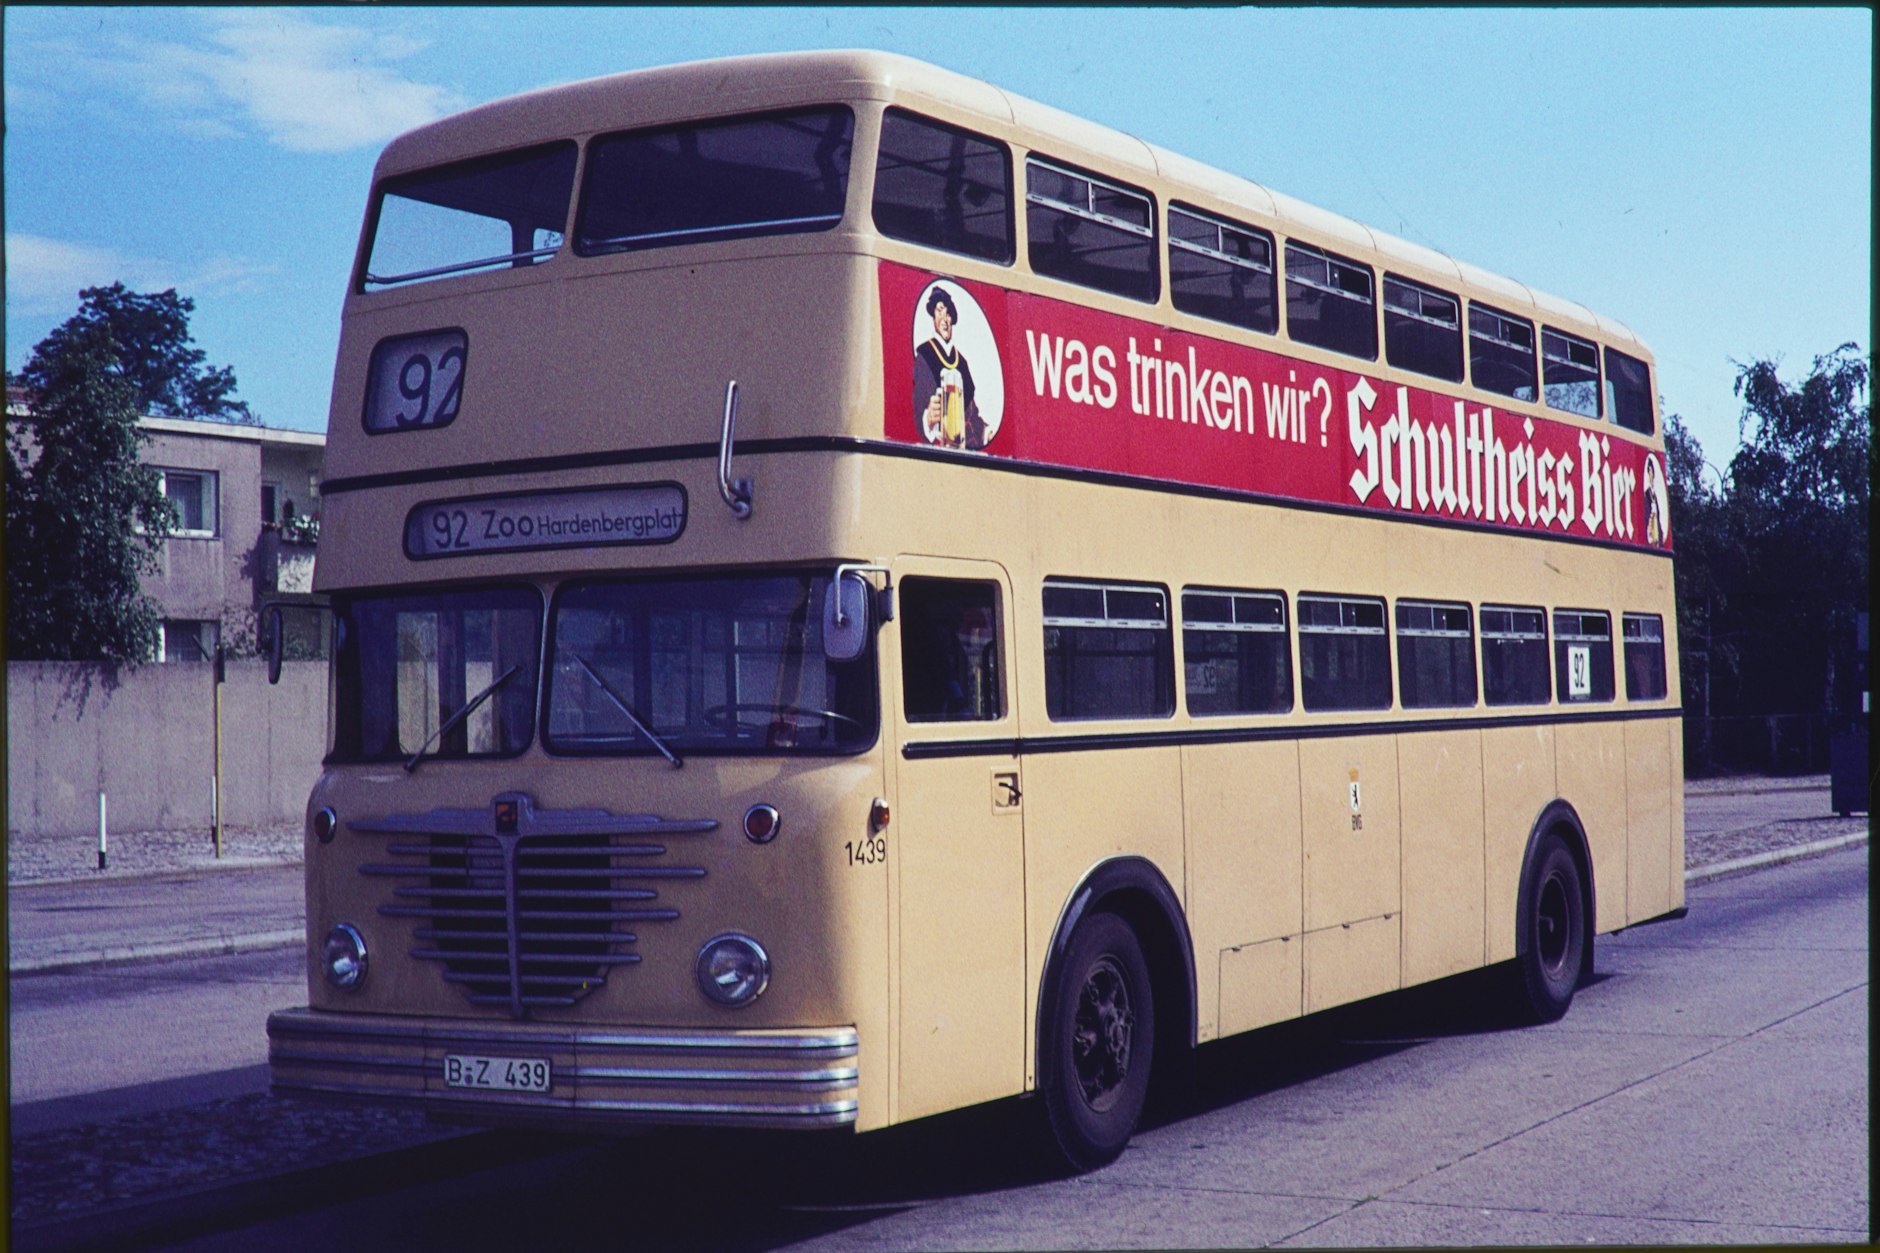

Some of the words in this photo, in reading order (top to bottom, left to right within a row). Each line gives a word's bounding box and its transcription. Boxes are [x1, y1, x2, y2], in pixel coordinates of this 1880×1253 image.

[396, 346, 464, 427] 92
[1126, 336, 1254, 435] trinken
[1262, 369, 1333, 448] wir?
[1347, 376, 1575, 531] Schultheiss
[1578, 429, 1636, 540] Bier
[432, 510, 470, 549] 92
[481, 510, 535, 540] Zoo
[537, 507, 684, 537] Hardenbergplat
[1574, 653, 1585, 688] 92
[844, 838, 886, 867] 1439
[504, 1061, 546, 1088] 439
